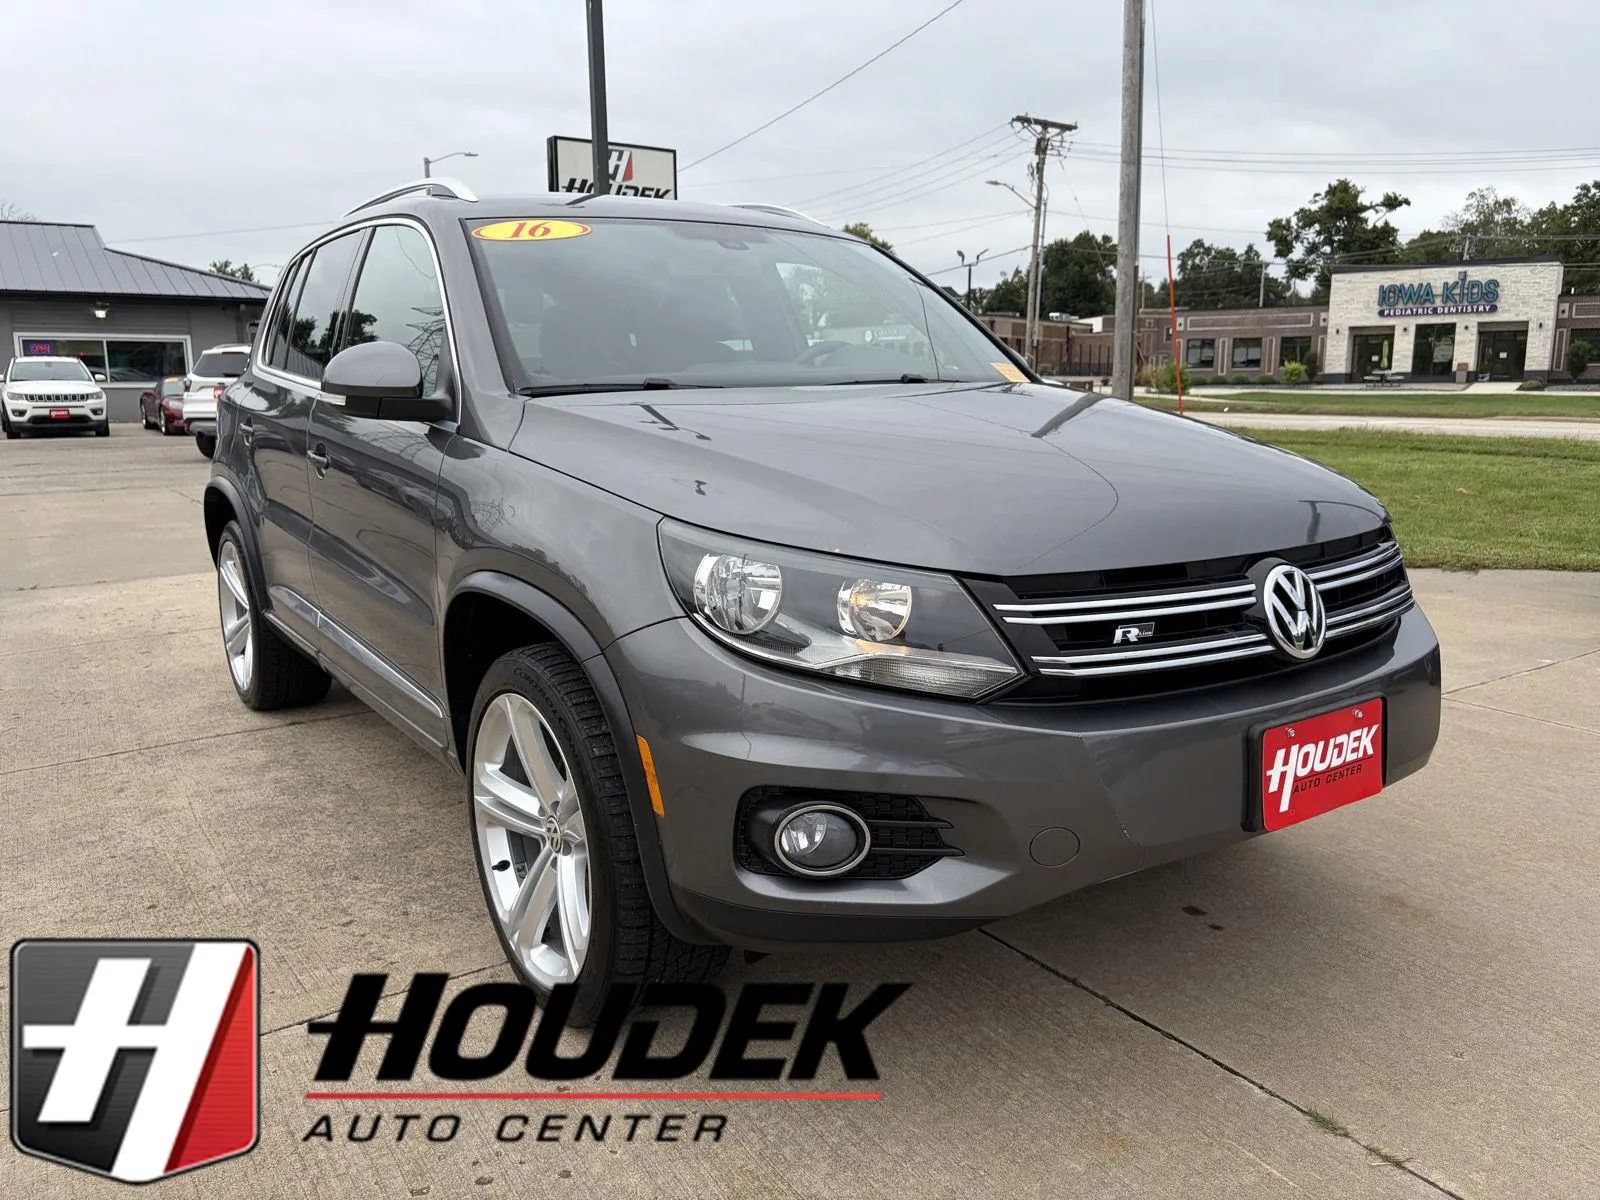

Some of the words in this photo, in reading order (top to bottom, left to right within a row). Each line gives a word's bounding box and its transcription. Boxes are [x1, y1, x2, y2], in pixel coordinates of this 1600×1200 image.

[511, 221, 551, 238] 16
[1378, 283, 1434, 306] IOWA
[1442, 271, 1499, 303] KIDS
[1384, 306, 1434, 316] PEDIATRIC
[1437, 304, 1491, 314] DENTISTRY
[1266, 724, 1379, 812] HOUDEK
[1293, 777, 1320, 793] AUTO
[1325, 764, 1362, 784] CENTER
